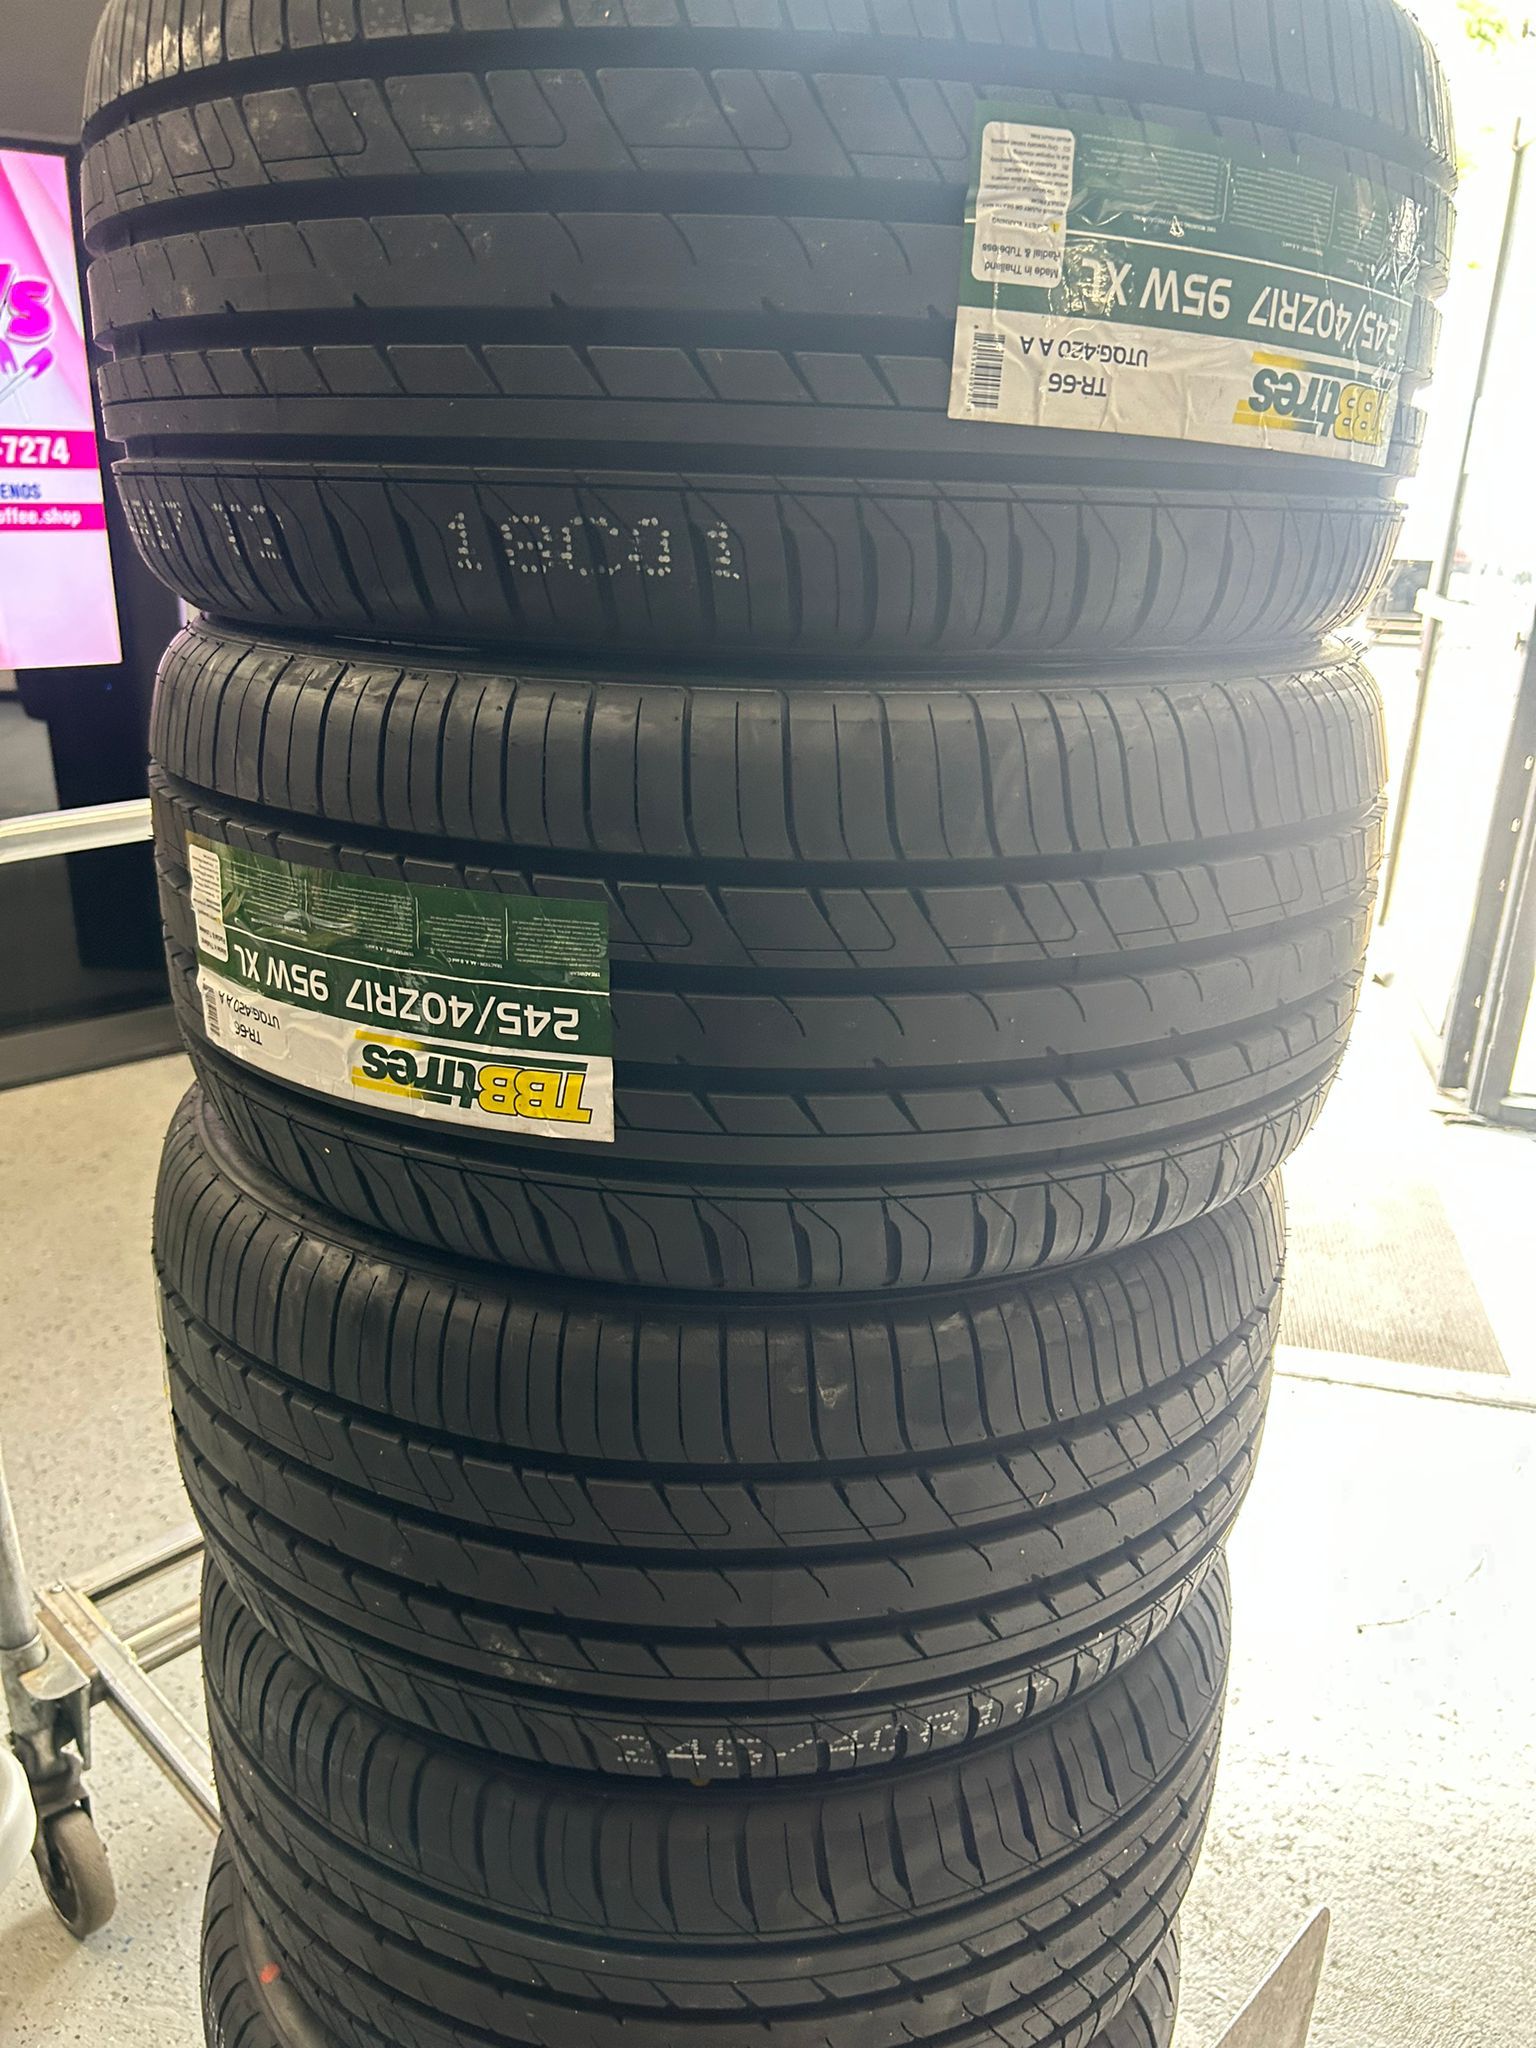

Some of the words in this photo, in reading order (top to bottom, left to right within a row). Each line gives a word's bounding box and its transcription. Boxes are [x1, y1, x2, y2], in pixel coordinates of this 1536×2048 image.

[1024, 248, 1030, 258] &
[1032, 248, 1061, 261] Radial
[1024, 266, 1033, 276] in
[1034, 266, 1059, 278] Made
[1139, 266, 1233, 320] 95W
[1020, 336, 1034, 354] A
[1038, 338, 1054, 354] A
[1047, 372, 1107, 397] TR-66
[233, 944, 261, 982] XL
[265, 956, 328, 1002] 95W
[344, 977, 580, 1042] 245/40ZR17
[233, 1020, 263, 1046] TR-66
